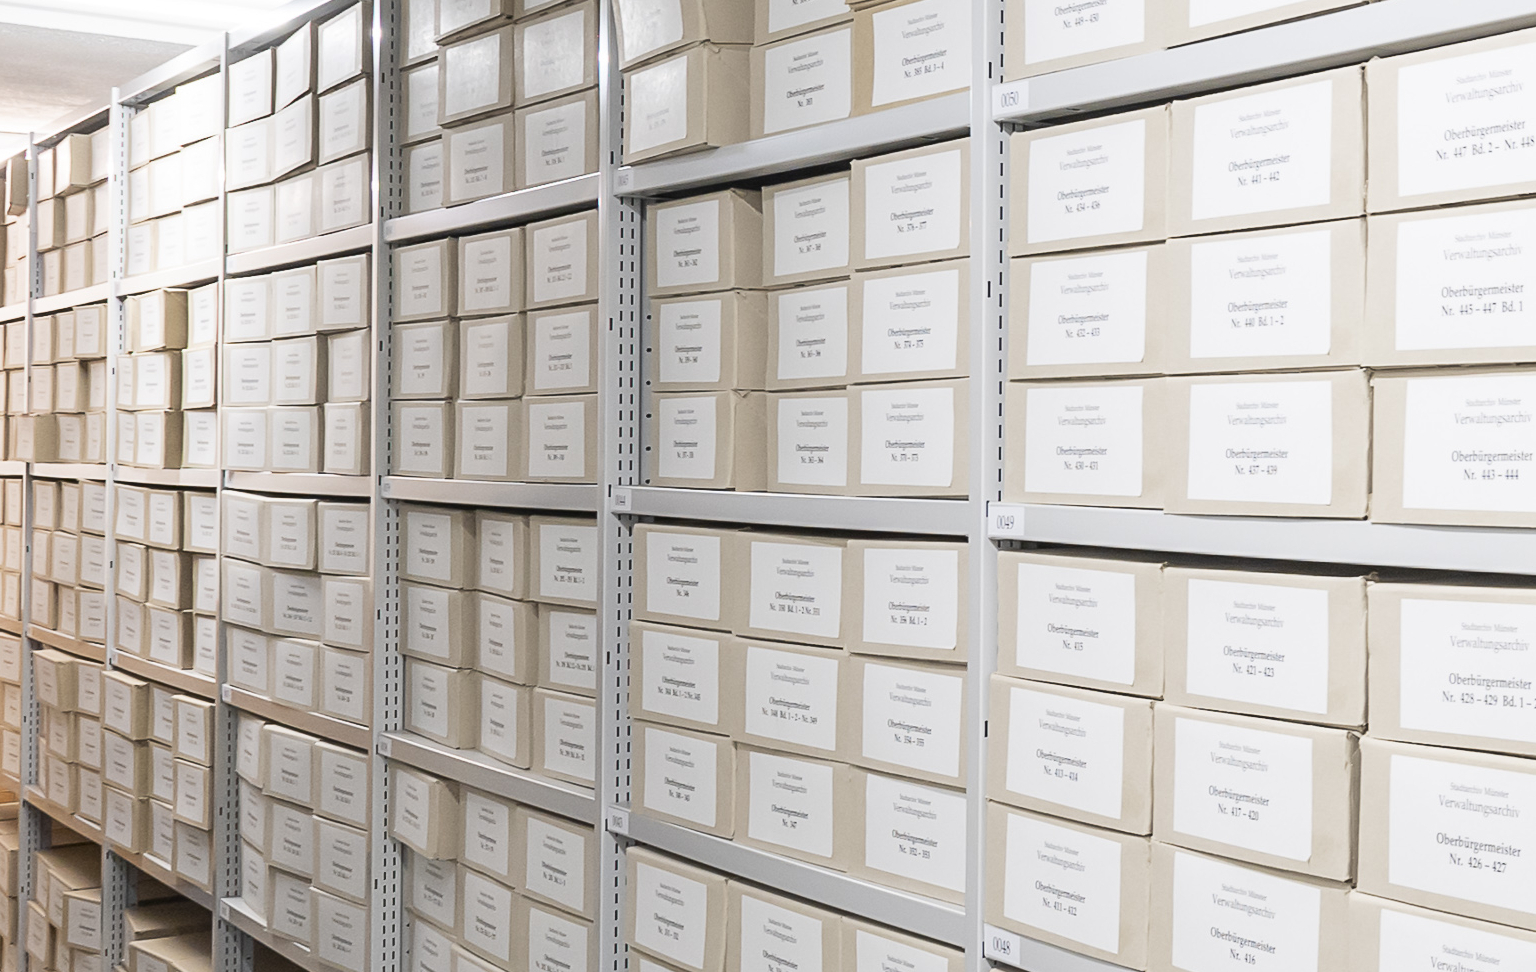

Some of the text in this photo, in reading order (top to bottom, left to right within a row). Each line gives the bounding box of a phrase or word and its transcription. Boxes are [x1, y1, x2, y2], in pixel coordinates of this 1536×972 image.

[1445, 81, 1522, 102] Verwaltungsarchiv
[1443, 120, 1525, 141] Oberbürgermeister
[1436, 135, 1534, 159] Nr. 447 Bd. 2 Nr. 448
[1228, 154, 1290, 172] Oberbürgermeister
[1443, 243, 1521, 261] Verwaltungsarchiv
[1441, 282, 1523, 299] Oberbürgermeister
[1227, 300, 1287, 313] Oberbürgermeister
[1441, 305, 1454, 315] Nr.
[1459, 303, 1472, 314] 445
[1482, 302, 1496, 313] 447
[1501, 300, 1515, 312] Bd.
[1454, 411, 1530, 426] Verwaltungsarchiv
[1225, 448, 1288, 461] Oberbürgermeister
[1451, 449, 1532, 465] Oberbürgermeister
[1464, 469, 1518, 479] Nr. 443 444
[997, 515, 1015, 529] 0049
[1449, 635, 1529, 653] Verwaltungsarchiv
[1223, 645, 1284, 662] Oberbürgermeister
[1448, 672, 1531, 690] Oberbürgermeister
[1442, 690, 1455, 702] Nr.
[1460, 692, 1474, 703] 428
[1483, 694, 1497, 705] 429
[1502, 695, 1516, 707] Bd.
[1210, 751, 1268, 771] Verwaltungsarchiv
[1208, 785, 1269, 806] Oberbürgermeister
[1483, 787, 1509, 798] Münster
[1438, 794, 1518, 817] Verwaltungsarchiv
[1436, 832, 1521, 857] Oberbürgermeister
[1449, 852, 1506, 872] Nr. 426 427
[1212, 893, 1275, 919] Verwaltungsarchiv
[993, 936, 1011, 955] 0048
[1210, 926, 1275, 953] Oberbürgermeister
[1475, 951, 1500, 965] Münster
